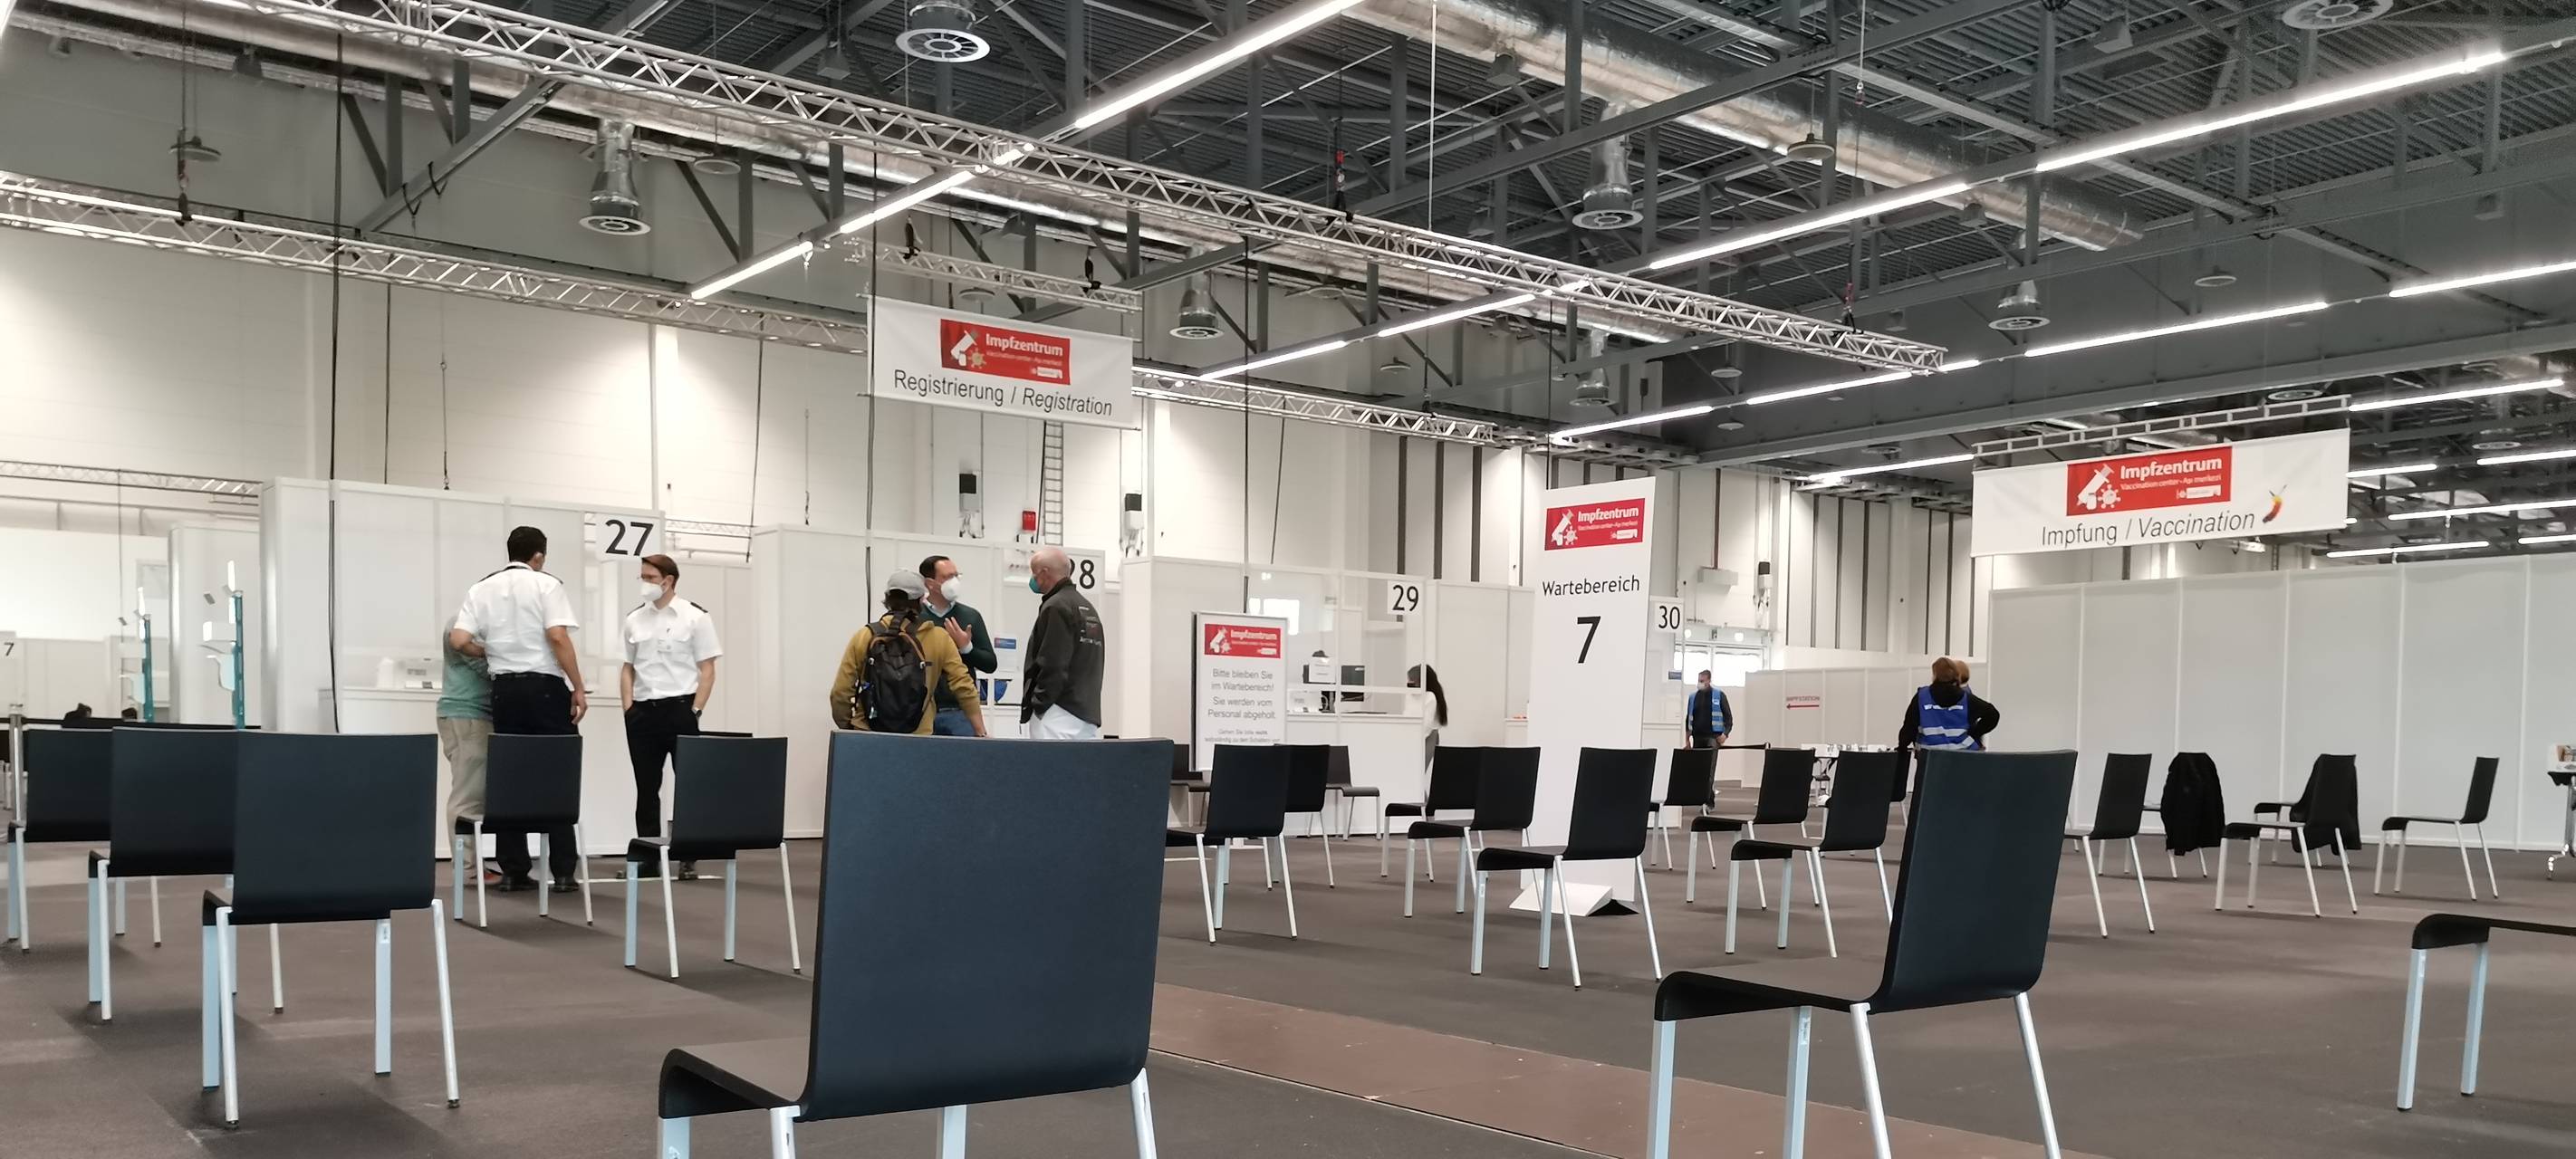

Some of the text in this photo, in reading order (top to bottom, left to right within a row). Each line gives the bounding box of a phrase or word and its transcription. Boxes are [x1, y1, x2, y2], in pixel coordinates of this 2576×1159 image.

[985, 333, 1063, 357] Impfzentrum
[894, 369, 1112, 417] Registrierung / Registration
[2120, 458, 2223, 481] Impfzentrum
[1578, 507, 1639, 523] Impfzentrum
[605, 519, 654, 556] 27
[2042, 512, 2255, 548] Impfung / Vaccination
[1392, 584, 1419, 611] 29
[1543, 575, 1640, 597] Wartebereich
[1658, 606, 1680, 629] 30
[1577, 616, 1601, 664] 7
